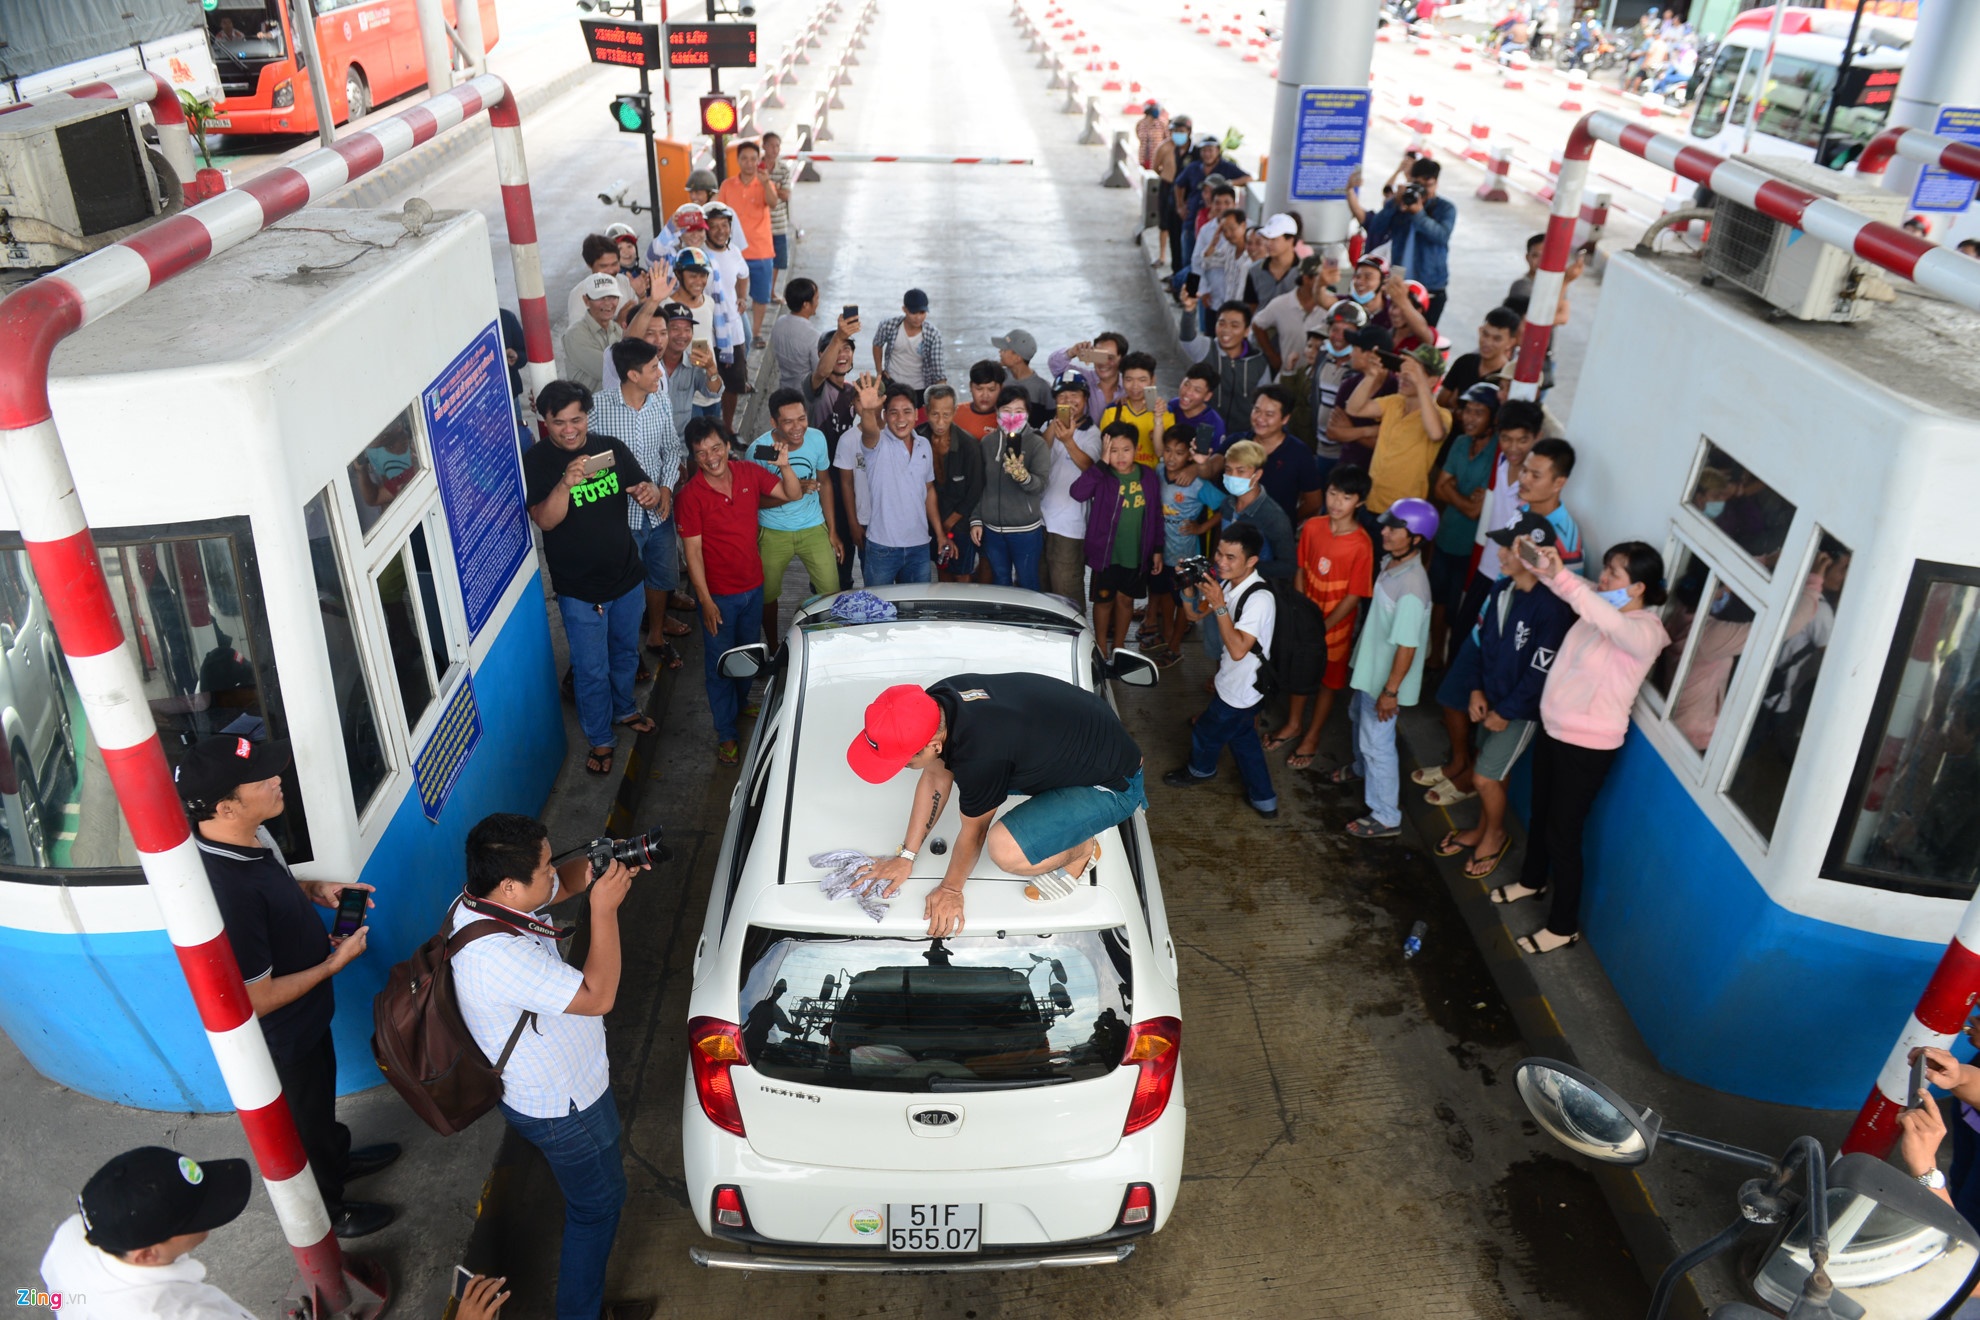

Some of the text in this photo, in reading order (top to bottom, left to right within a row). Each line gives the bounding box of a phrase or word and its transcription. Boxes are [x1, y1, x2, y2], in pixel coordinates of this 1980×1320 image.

[570, 472, 619, 507] FURY
[528, 922, 555, 936] Canon
[761, 1085, 821, 1103] morning
[920, 1113, 951, 1124] KIA
[911, 1204, 959, 1226] 51F
[892, 1228, 977, 1250] 555.07
